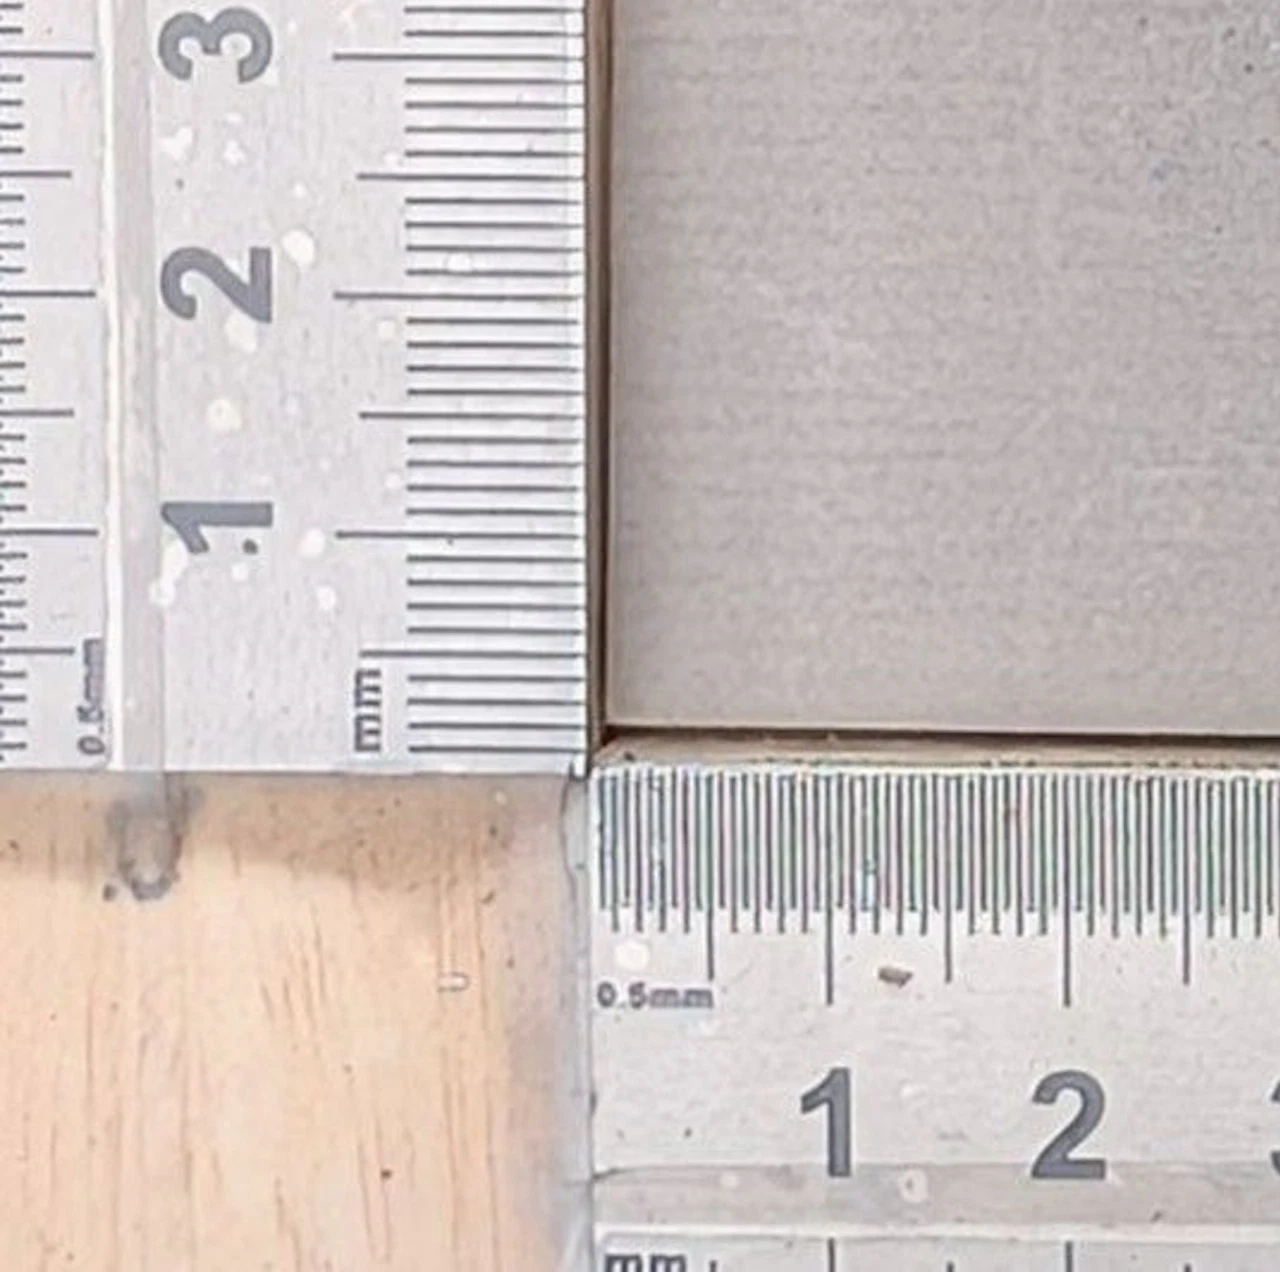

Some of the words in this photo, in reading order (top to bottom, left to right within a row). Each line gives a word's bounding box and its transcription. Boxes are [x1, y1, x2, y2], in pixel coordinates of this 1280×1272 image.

[158, 8, 273, 84] 3
[160, 247, 272, 324] 2
[160, 502, 273, 553] 1
[354, 669, 381, 752] mm
[596, 982, 714, 1010] 0.5mm
[801, 1068, 852, 1178] 1
[1030, 1070, 1106, 1181] 2
